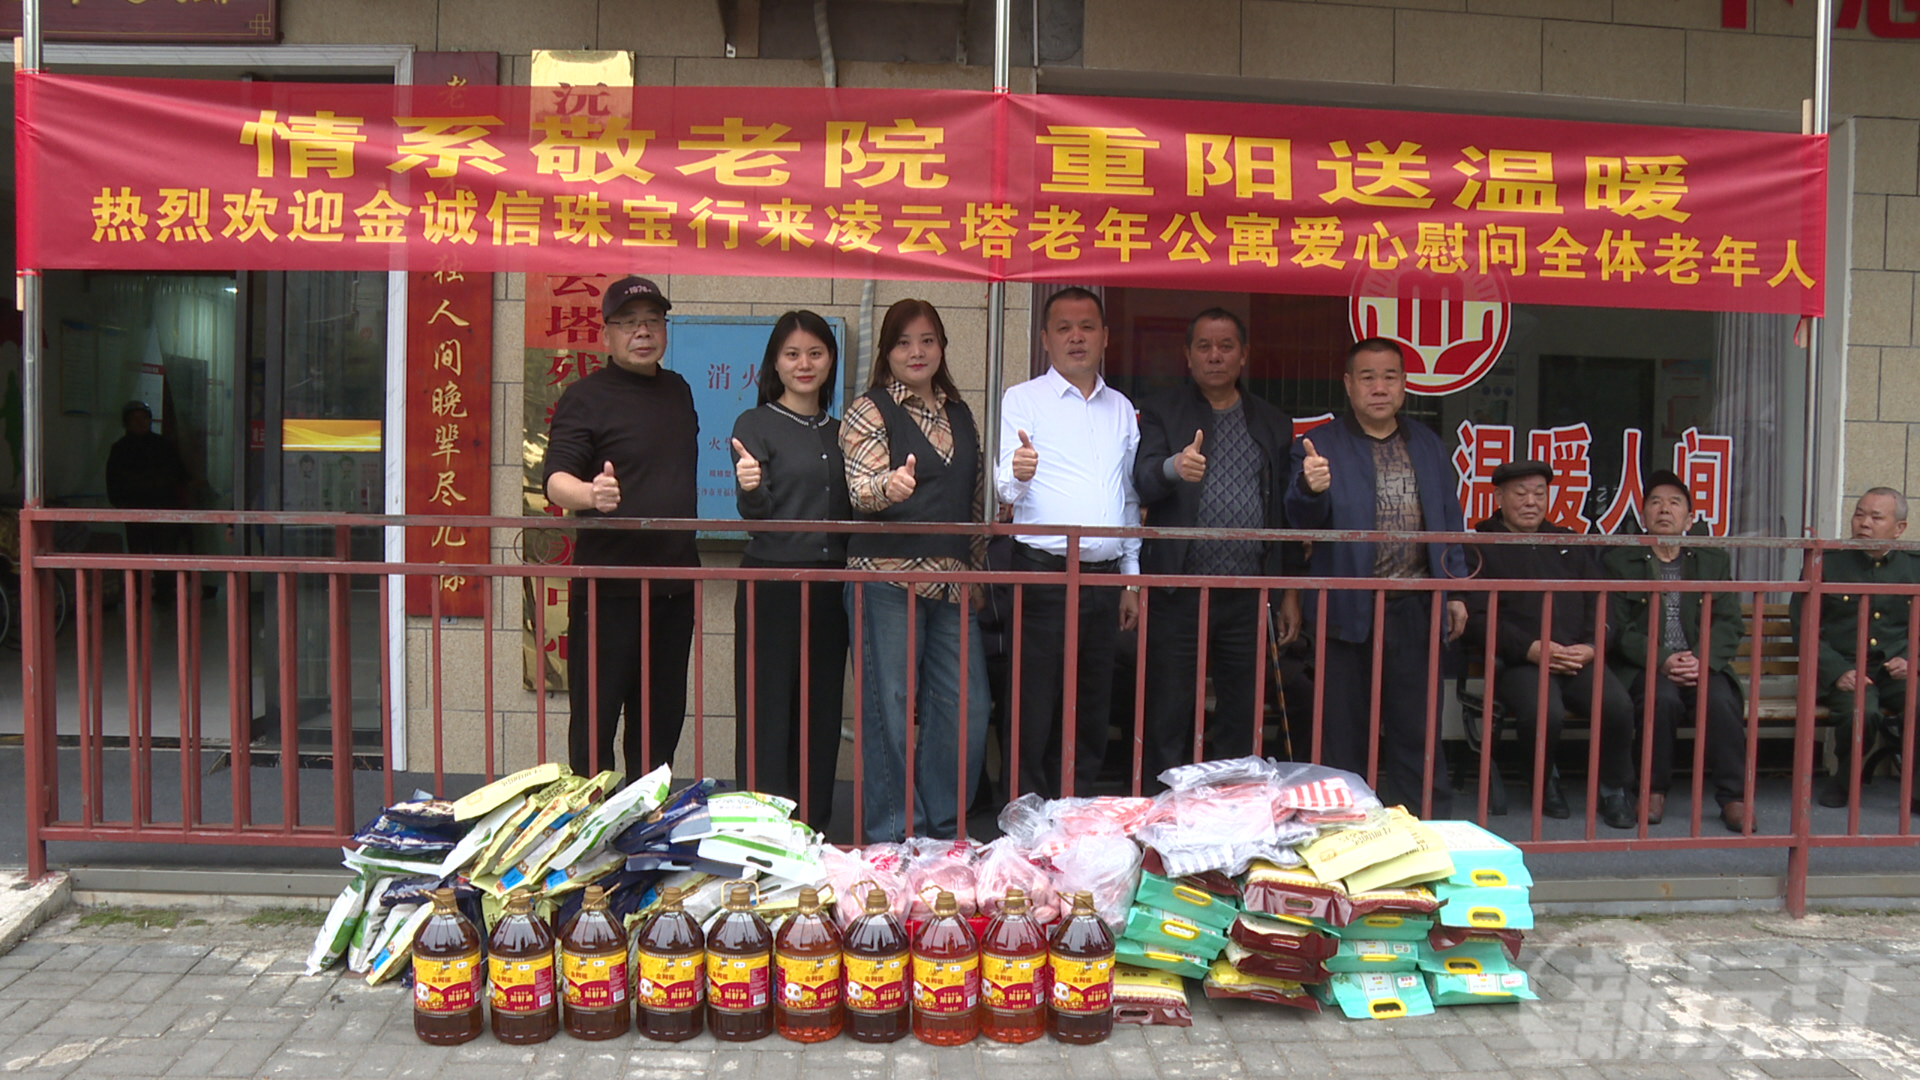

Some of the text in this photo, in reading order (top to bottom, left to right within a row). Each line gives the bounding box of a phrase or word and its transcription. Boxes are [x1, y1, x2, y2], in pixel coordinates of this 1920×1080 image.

[240, 110, 1691, 223] 情系敬老院 重阳送温暖
[92, 186, 1816, 289] 热烈欢迎金诚信珠宝行来凌云塔老年公寓爱心慰问全体老年人
[1451, 419, 1734, 538] 温暖人间
